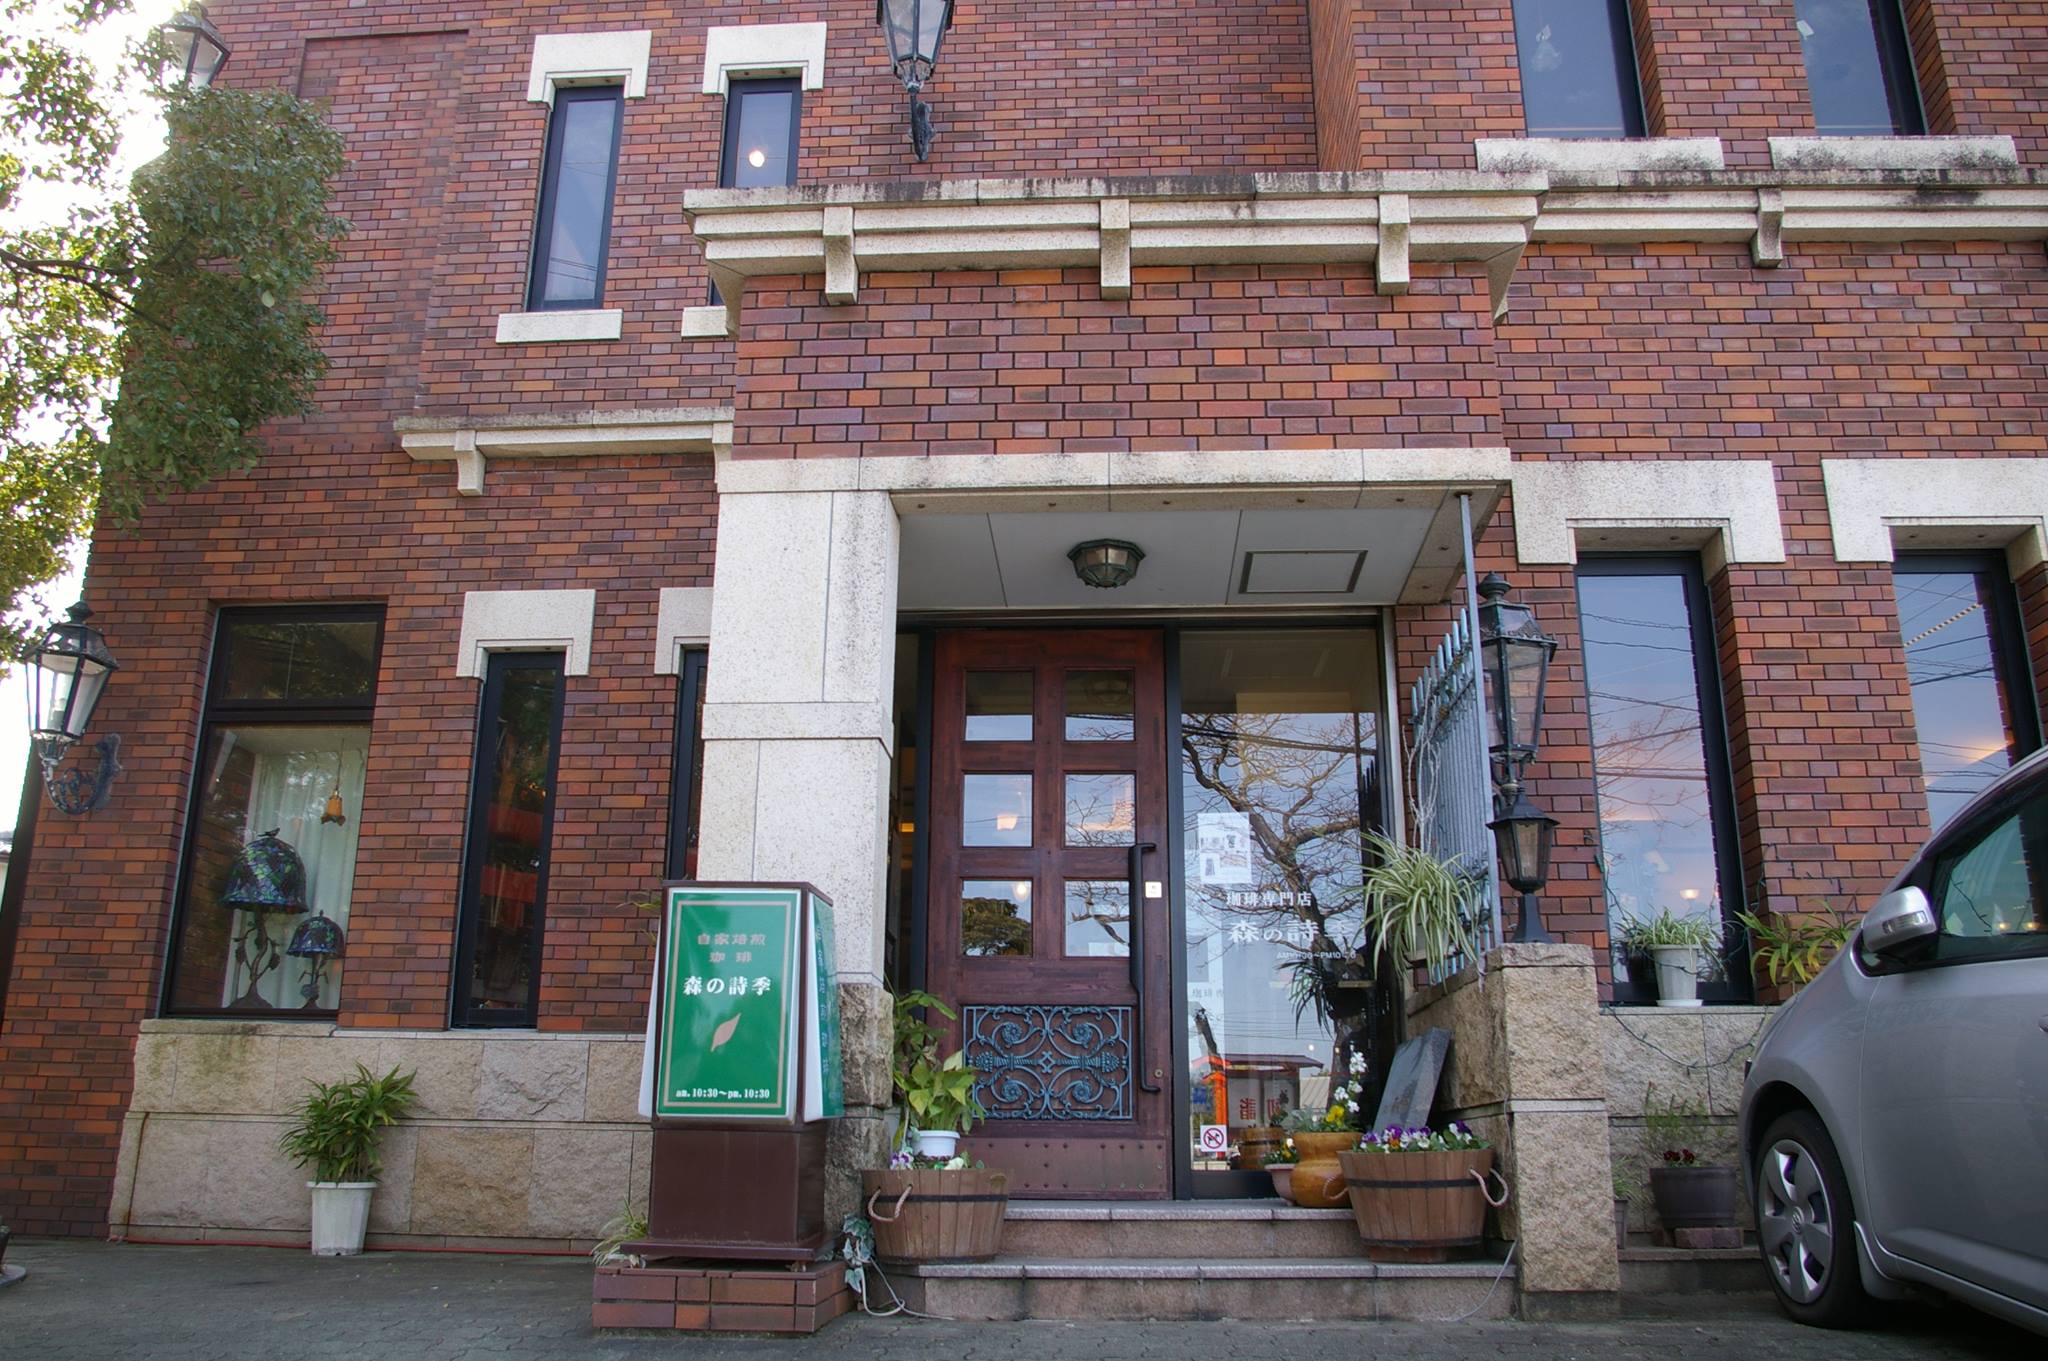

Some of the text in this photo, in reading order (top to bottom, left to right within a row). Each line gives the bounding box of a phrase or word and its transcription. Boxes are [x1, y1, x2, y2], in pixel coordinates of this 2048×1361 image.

[1226, 891, 1312, 907] 珈琲専門店
[697, 933, 767, 946] 自家焙煎
[1228, 918, 1355, 945] 森の詩季
[709, 950, 753, 963] 珈琲
[683, 975, 771, 996] 森の詩季
